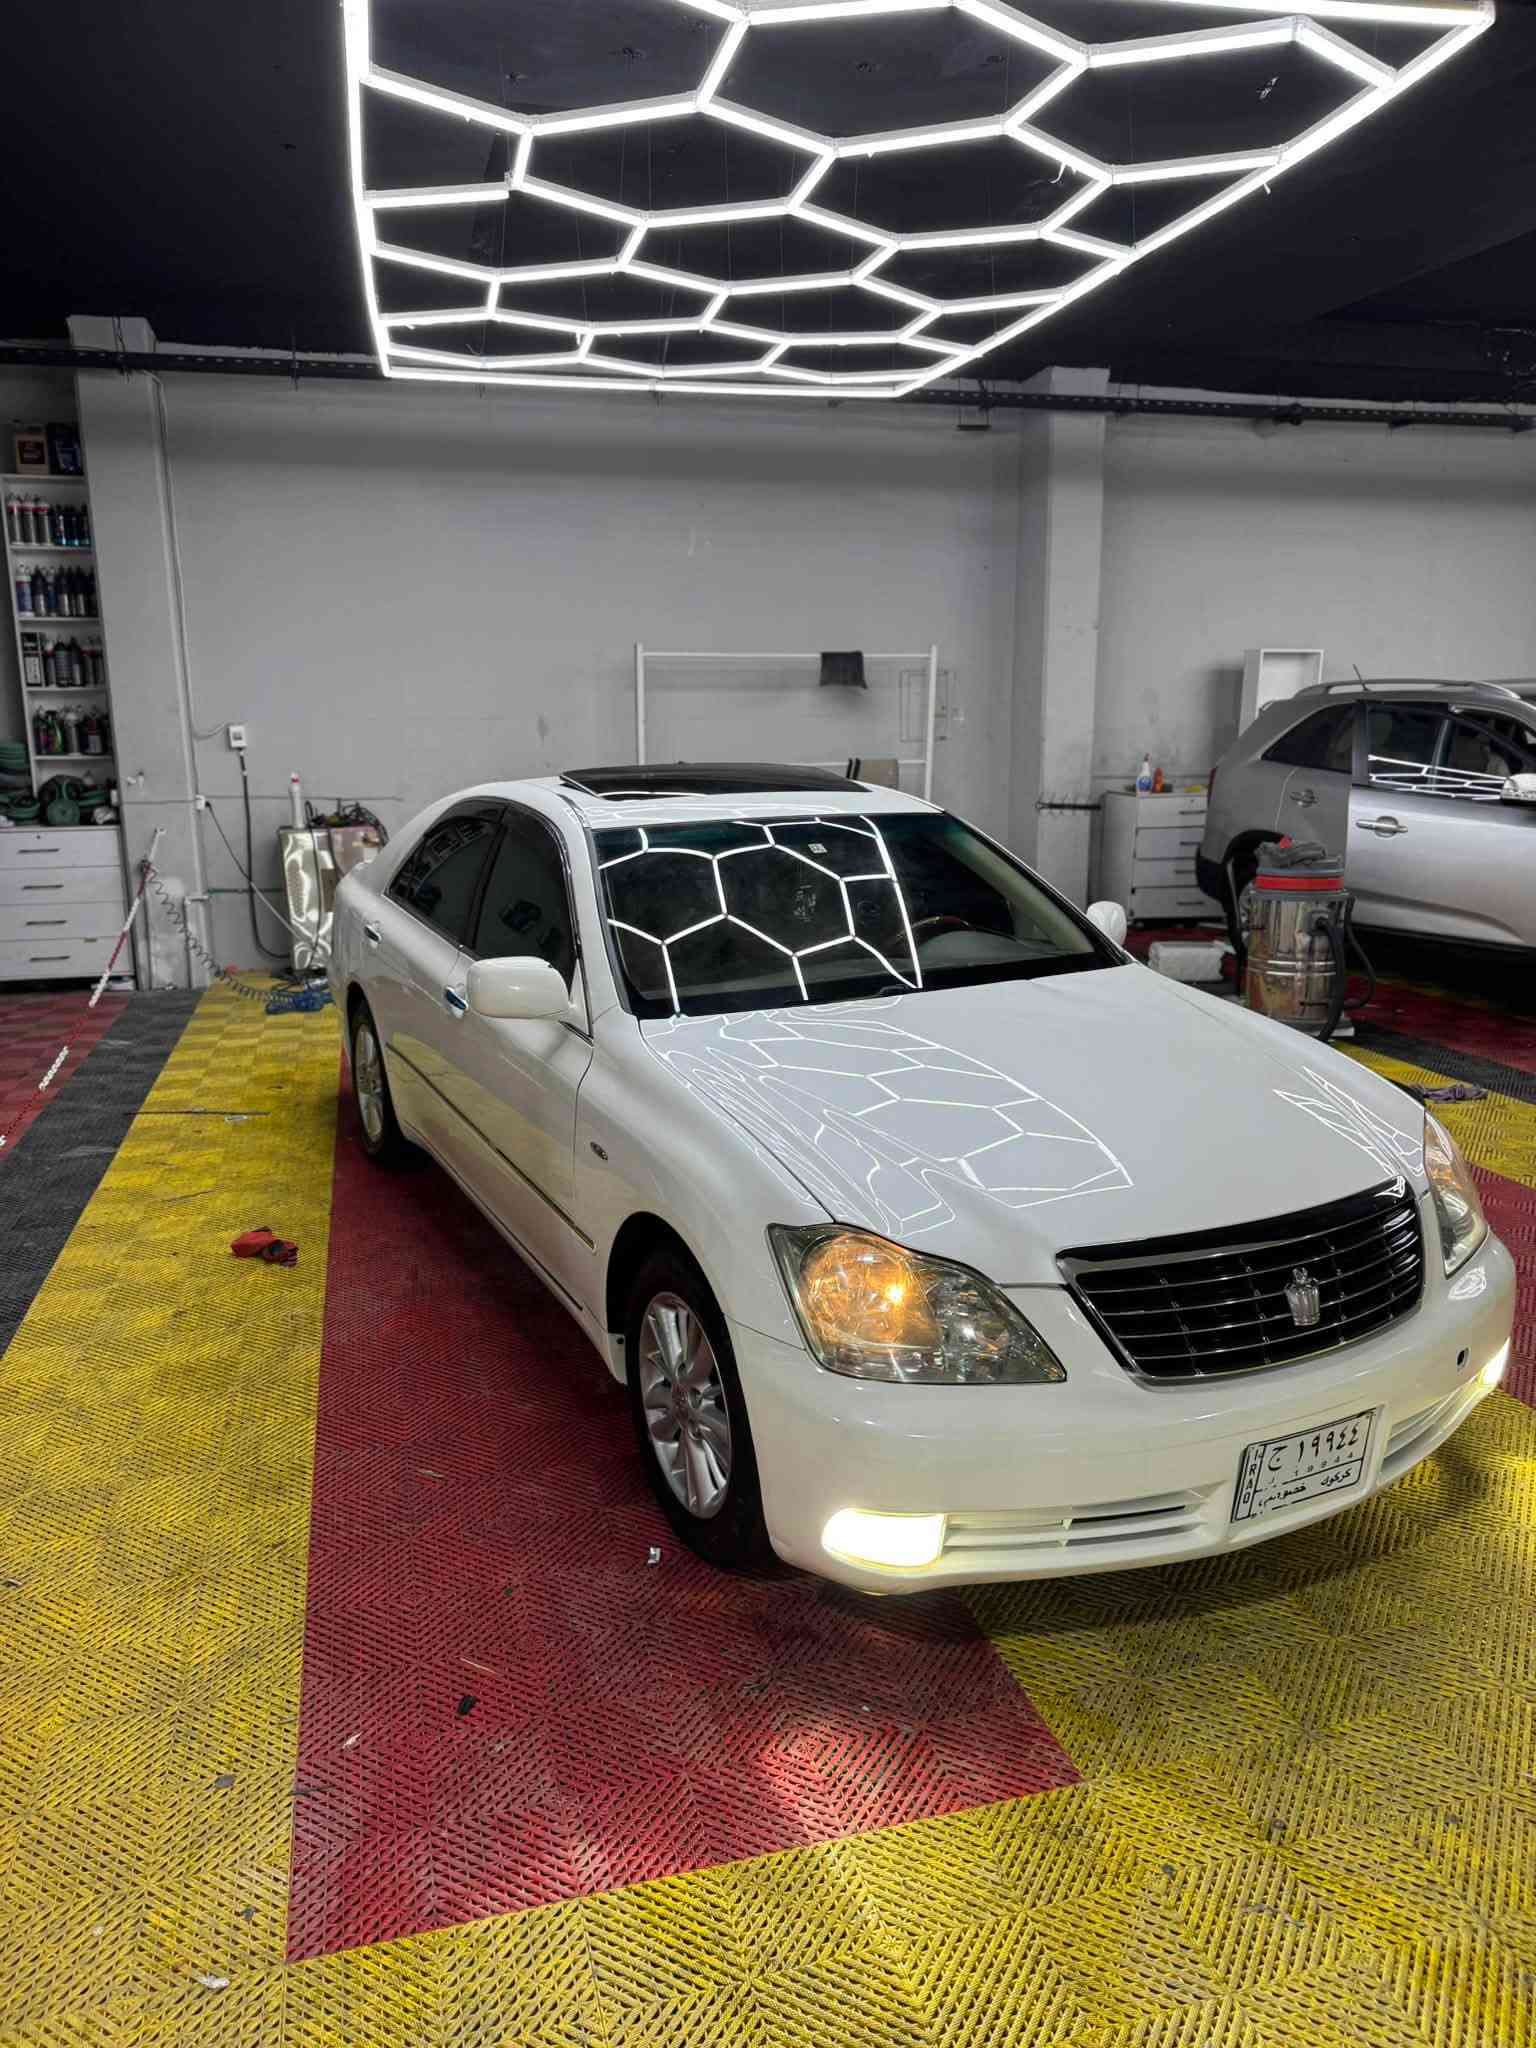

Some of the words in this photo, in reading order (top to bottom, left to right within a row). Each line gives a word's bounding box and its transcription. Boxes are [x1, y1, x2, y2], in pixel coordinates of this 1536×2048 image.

[1297, 1421, 1361, 1463] ١٩٩٤٤
[1267, 1445, 1289, 1472] ج
[1320, 1467, 1353, 1487] كركوك
